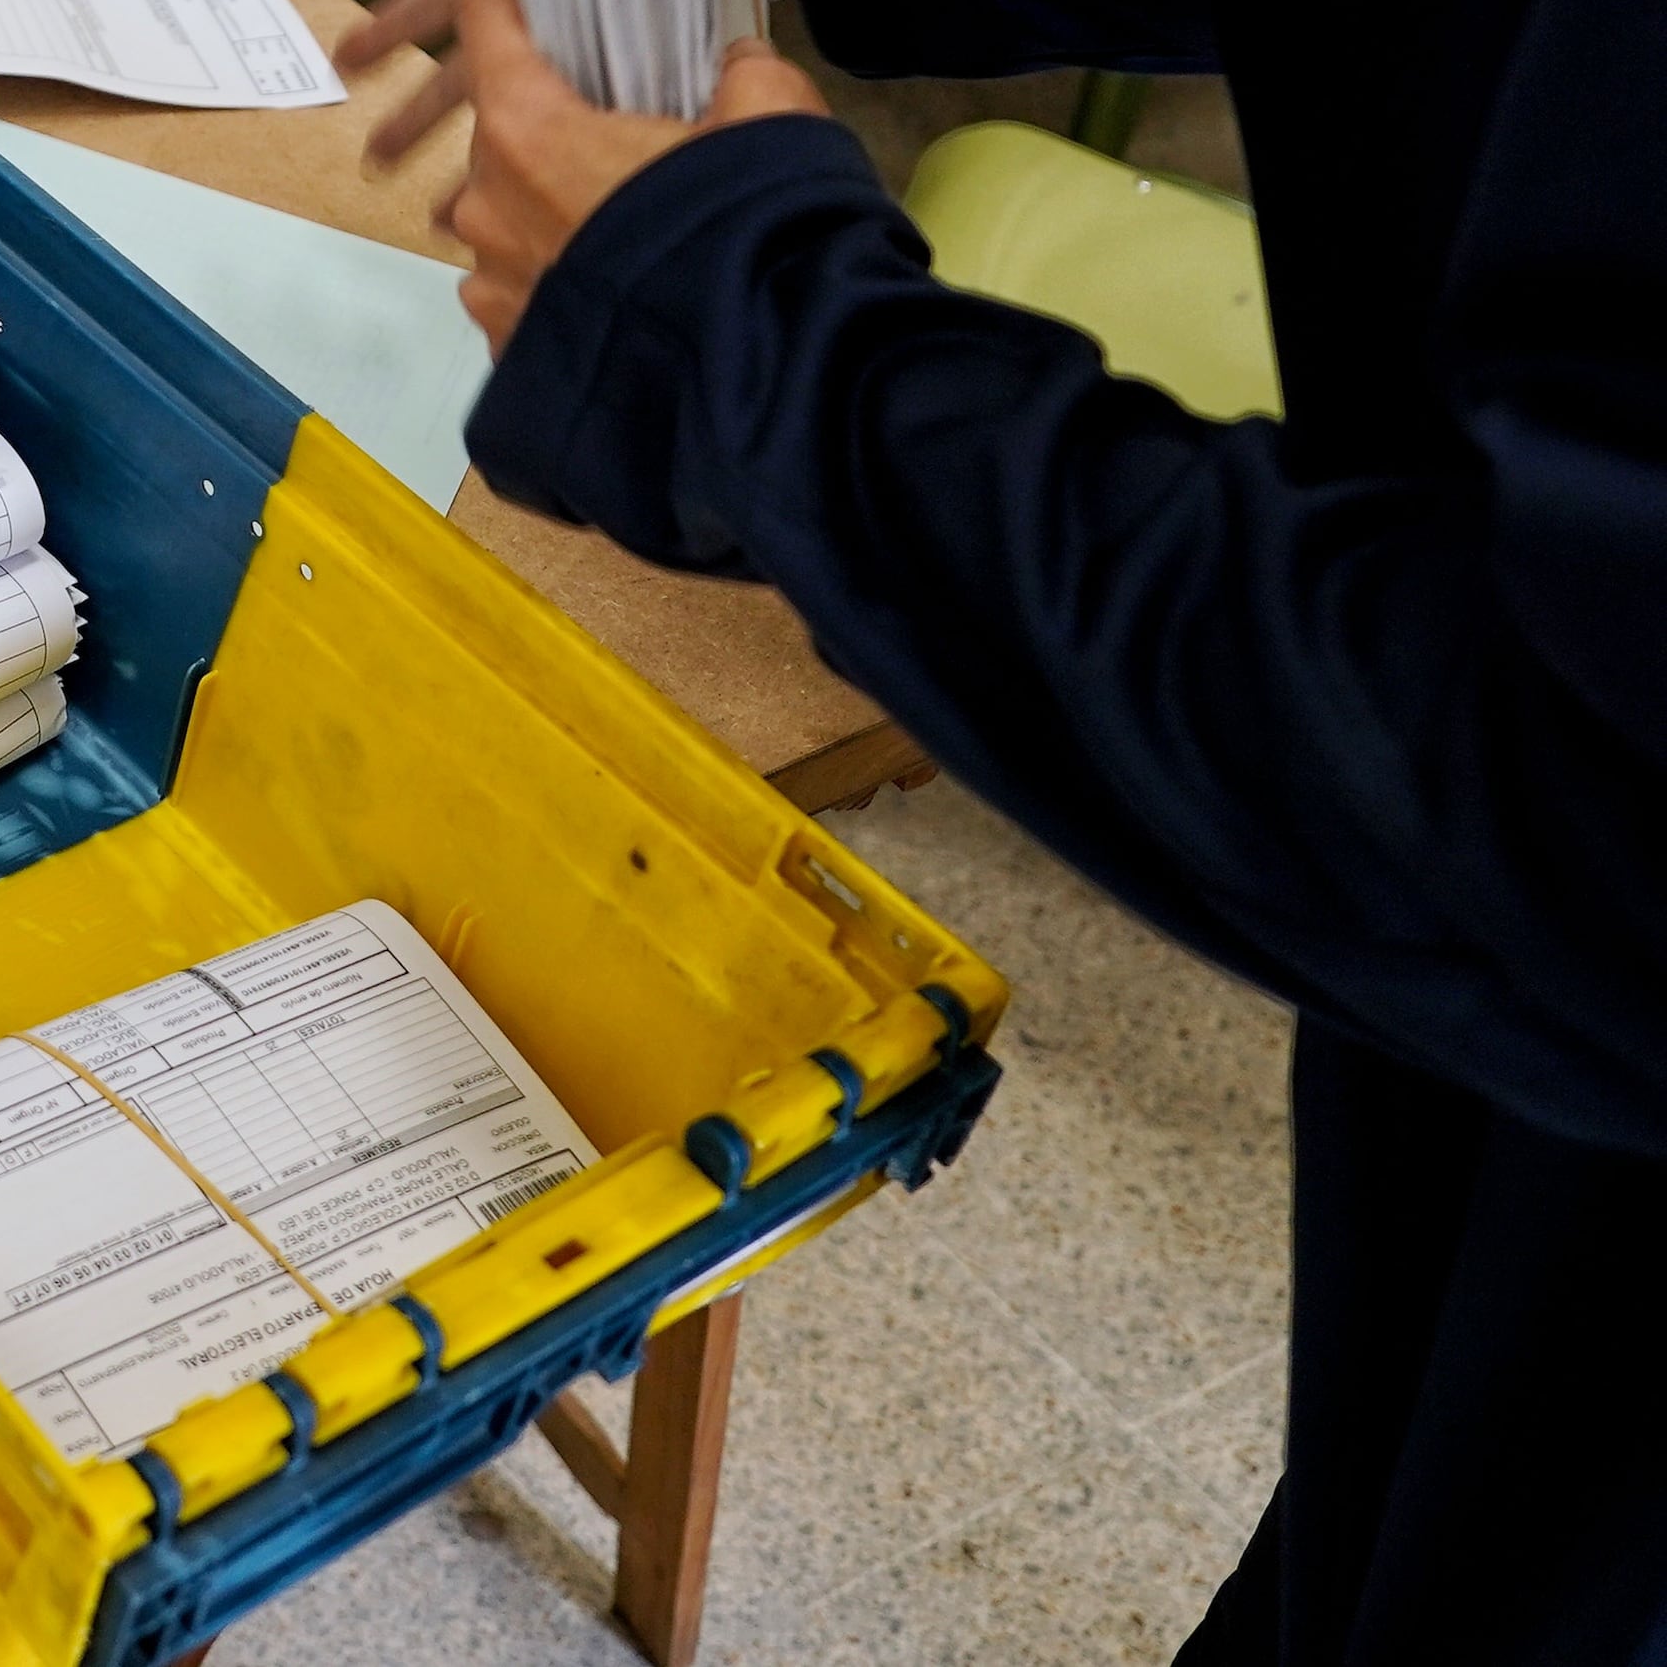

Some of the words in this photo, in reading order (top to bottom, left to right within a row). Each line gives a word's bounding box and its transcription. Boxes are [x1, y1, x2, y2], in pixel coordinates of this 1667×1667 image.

[308, 986, 322, 1000] de
[321, 970, 362, 995] Número
[197, 996, 223, 1014] Voto
[160, 1007, 198, 1030] Emitido
[297, 1010, 345, 1039] TOTALES
[57, 1018, 126, 1054] VALLADOLID
[110, 1027, 135, 1044] SUC
[180, 1025, 226, 1052] Producto
[100, 1062, 137, 1086] Origen
[451, 1063, 500, 1092] Electorales
[6, 1102, 43, 1126] Origen
[423, 1094, 463, 1118] Producto
[331, 1133, 371, 1157] Cantidad
[350, 1135, 401, 1164] RESUMEN
[389, 1143, 459, 1182] VALLADOLID
[393, 1172, 432, 1198] PADRE
[318, 1186, 362, 1214] PONCE
[326, 1189, 395, 1227] FRANCISCO
[301, 1205, 320, 1221] DE
[349, 1203, 402, 1234] COLEGIO
[154, 1227, 172, 1244] 01
[279, 1219, 328, 1248] SUAREZ
[112, 1246, 132, 1264] 03
[131, 1237, 152, 1255] 02
[281, 1236, 326, 1265] PONCE
[72, 1263, 92, 1281] 05
[92, 1254, 112, 1273] 04
[181, 1250, 254, 1290] VALLADOLID
[32, 1281, 52, 1299] 07
[52, 1272, 72, 1290] 06
[352, 1266, 394, 1295] HOJA
[10, 1289, 32, 1309] FT
[330, 1285, 353, 1305] DE
[260, 1298, 323, 1336] EPARTO
[175, 1324, 263, 1374] ELECTORAL
